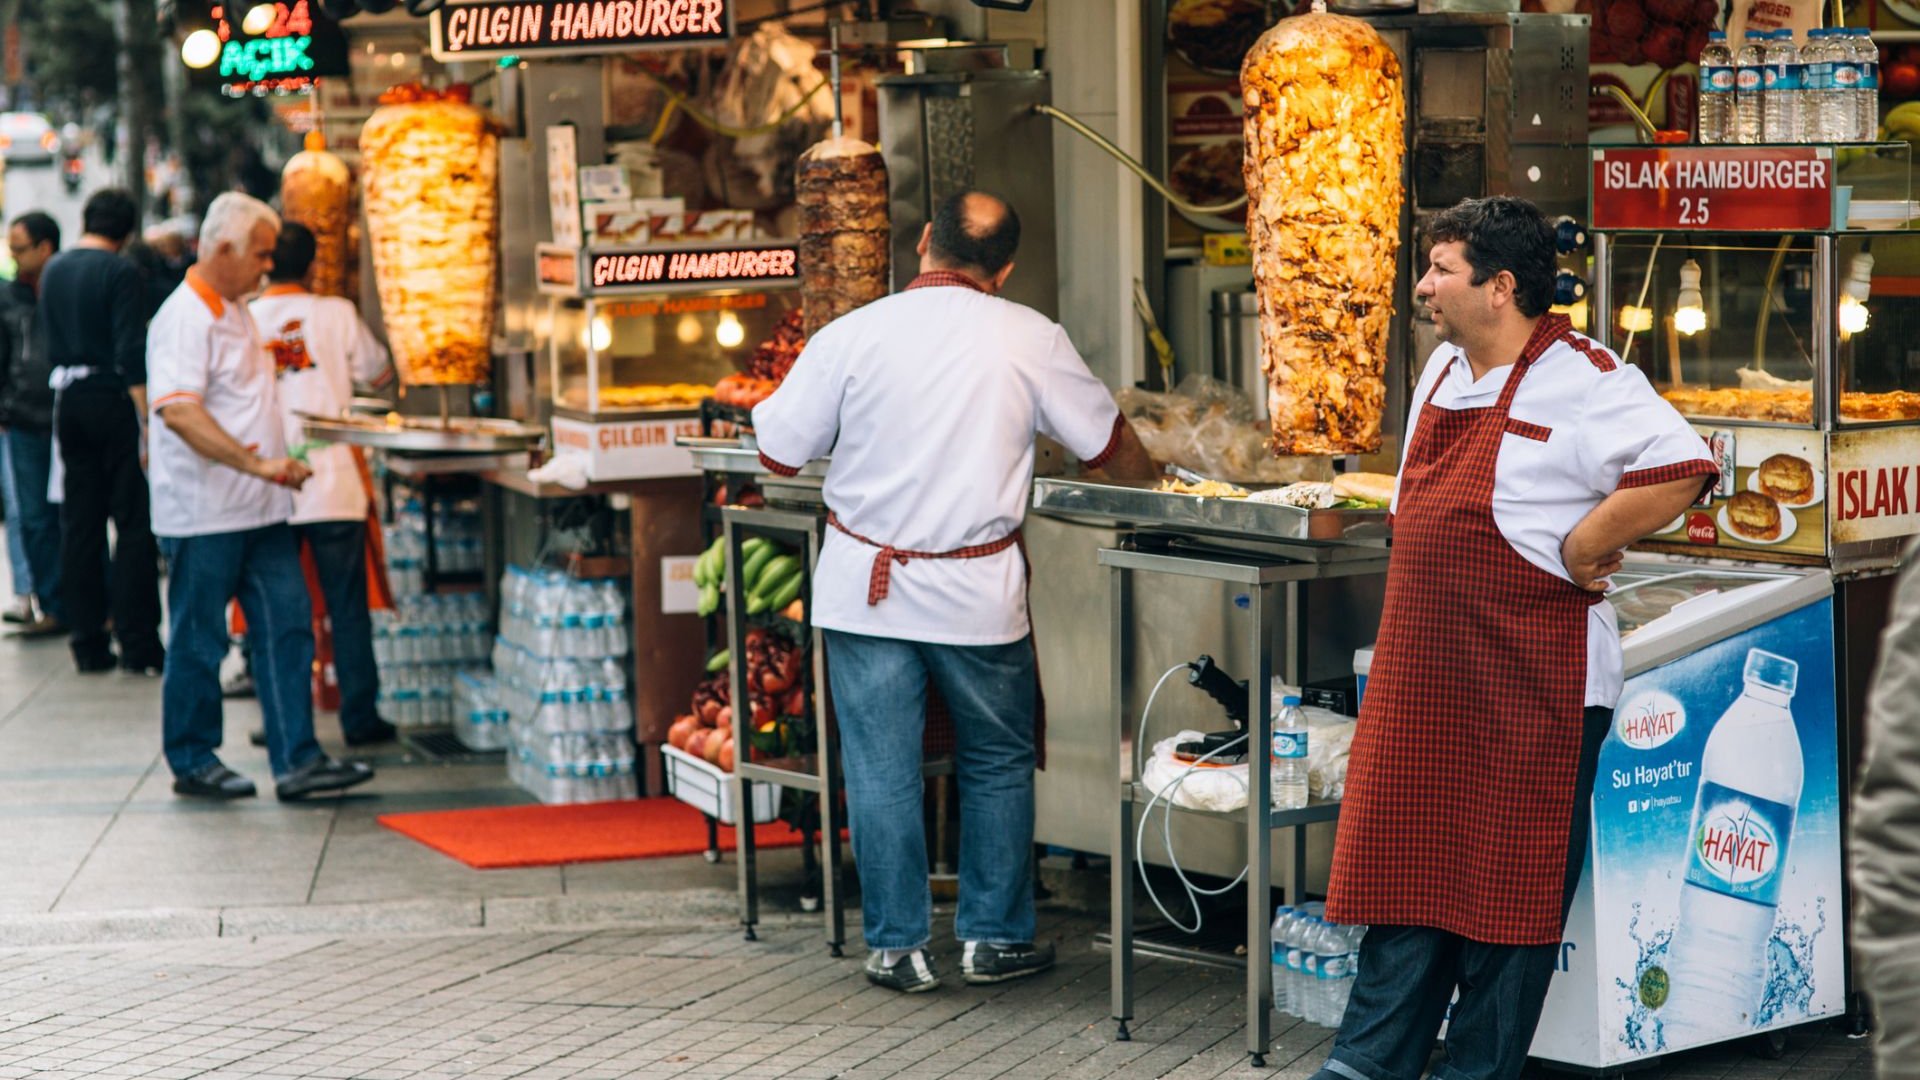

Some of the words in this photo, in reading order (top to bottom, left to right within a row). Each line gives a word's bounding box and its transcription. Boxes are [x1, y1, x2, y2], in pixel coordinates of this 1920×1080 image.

[449, 5, 543, 50] ÇILGIN
[551, 0, 723, 40] HAMBURGER
[220, 35, 314, 82] AÇIK
[1604, 161, 1670, 189] ISLAK
[1676, 160, 1827, 189] HAMBURGER
[1678, 198, 1709, 224] 2.5
[594, 254, 665, 286] ÇILGIN
[669, 249, 796, 279] HAMBURGER
[598, 424, 667, 452] ÇILGIN
[1837, 466, 1909, 522] ISLAK
[1626, 711, 1677, 741] HAYAT
[1612, 769, 1631, 789] Su
[1704, 827, 1771, 873] HAYAT
